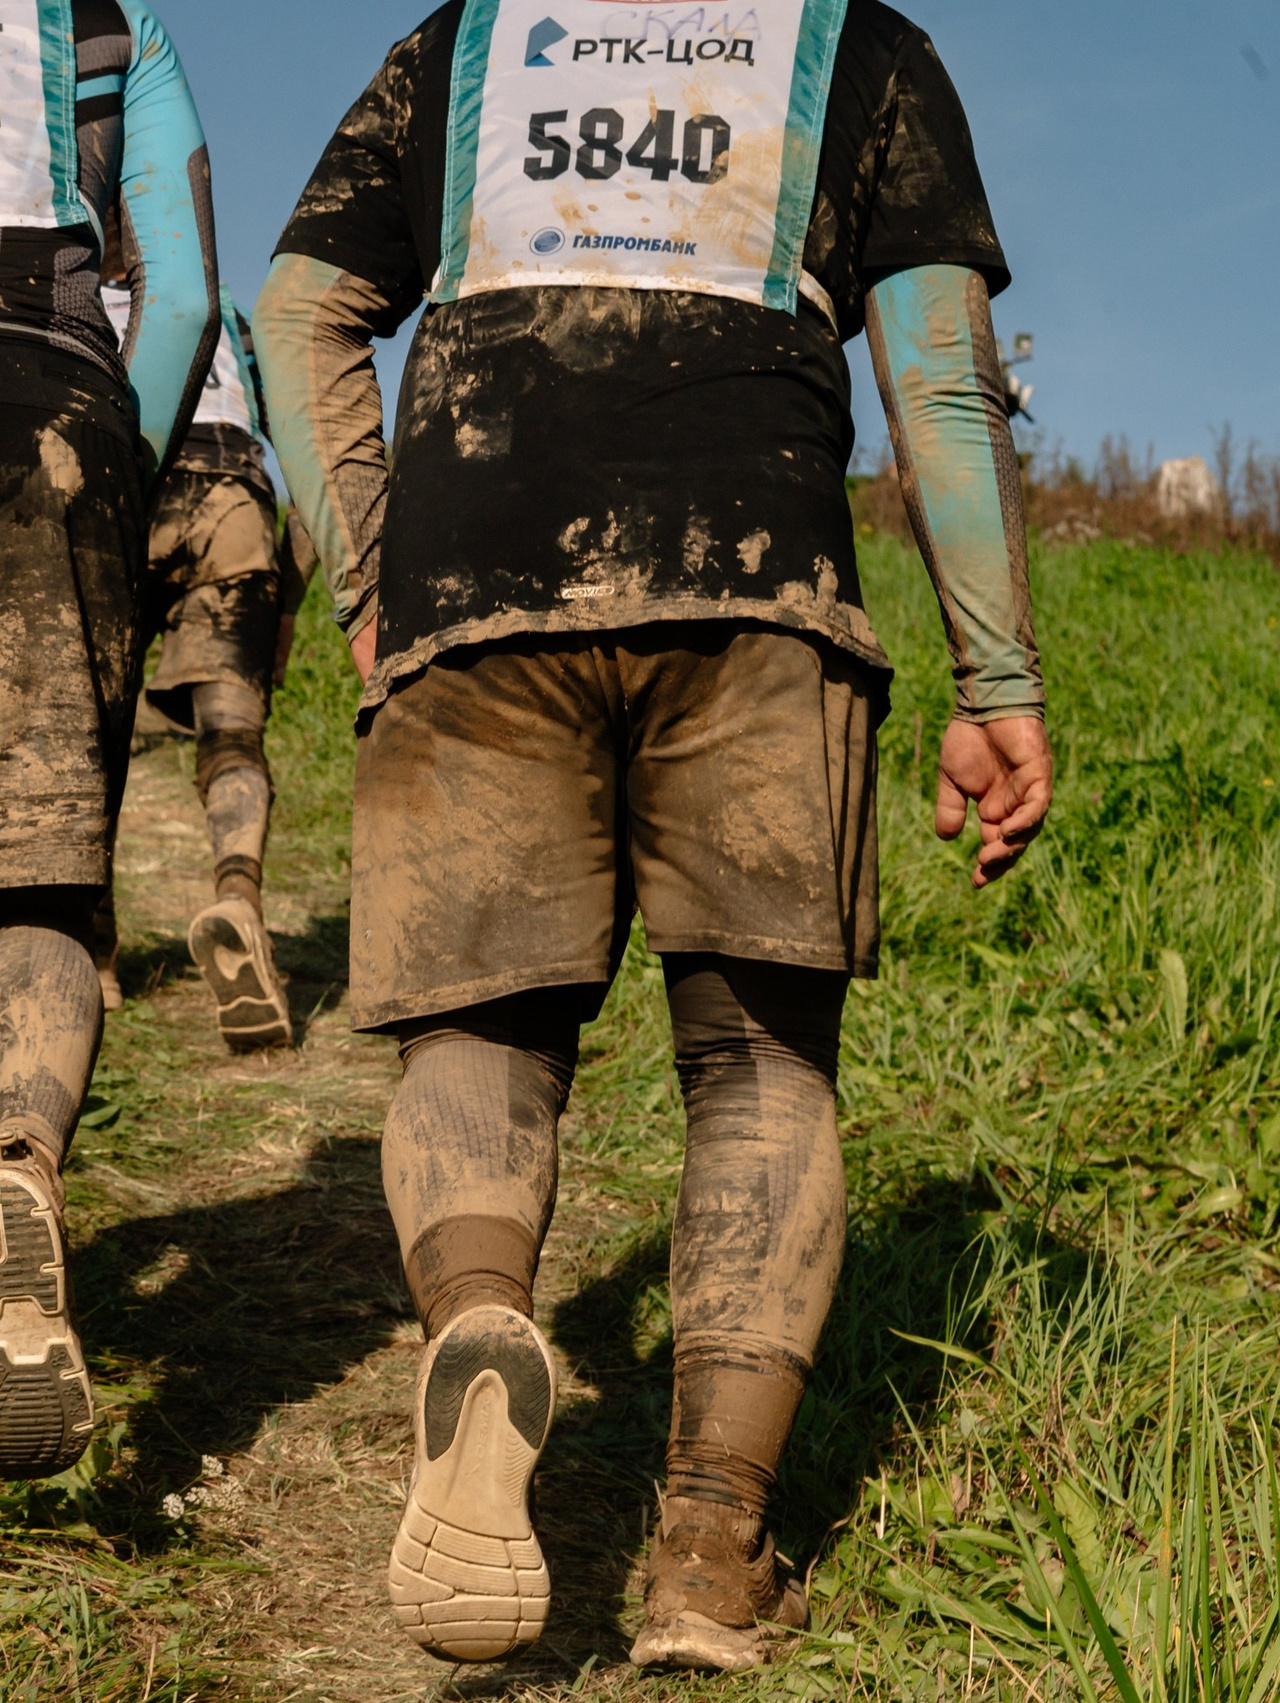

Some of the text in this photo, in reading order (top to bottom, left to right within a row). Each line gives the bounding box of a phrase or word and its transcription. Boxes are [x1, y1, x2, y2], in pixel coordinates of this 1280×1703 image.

[572, 39, 755, 67] РТК-ЦОД
[523, 107, 731, 185] 5840
[572, 234, 697, 256] ГАЗПРОМБАНК
